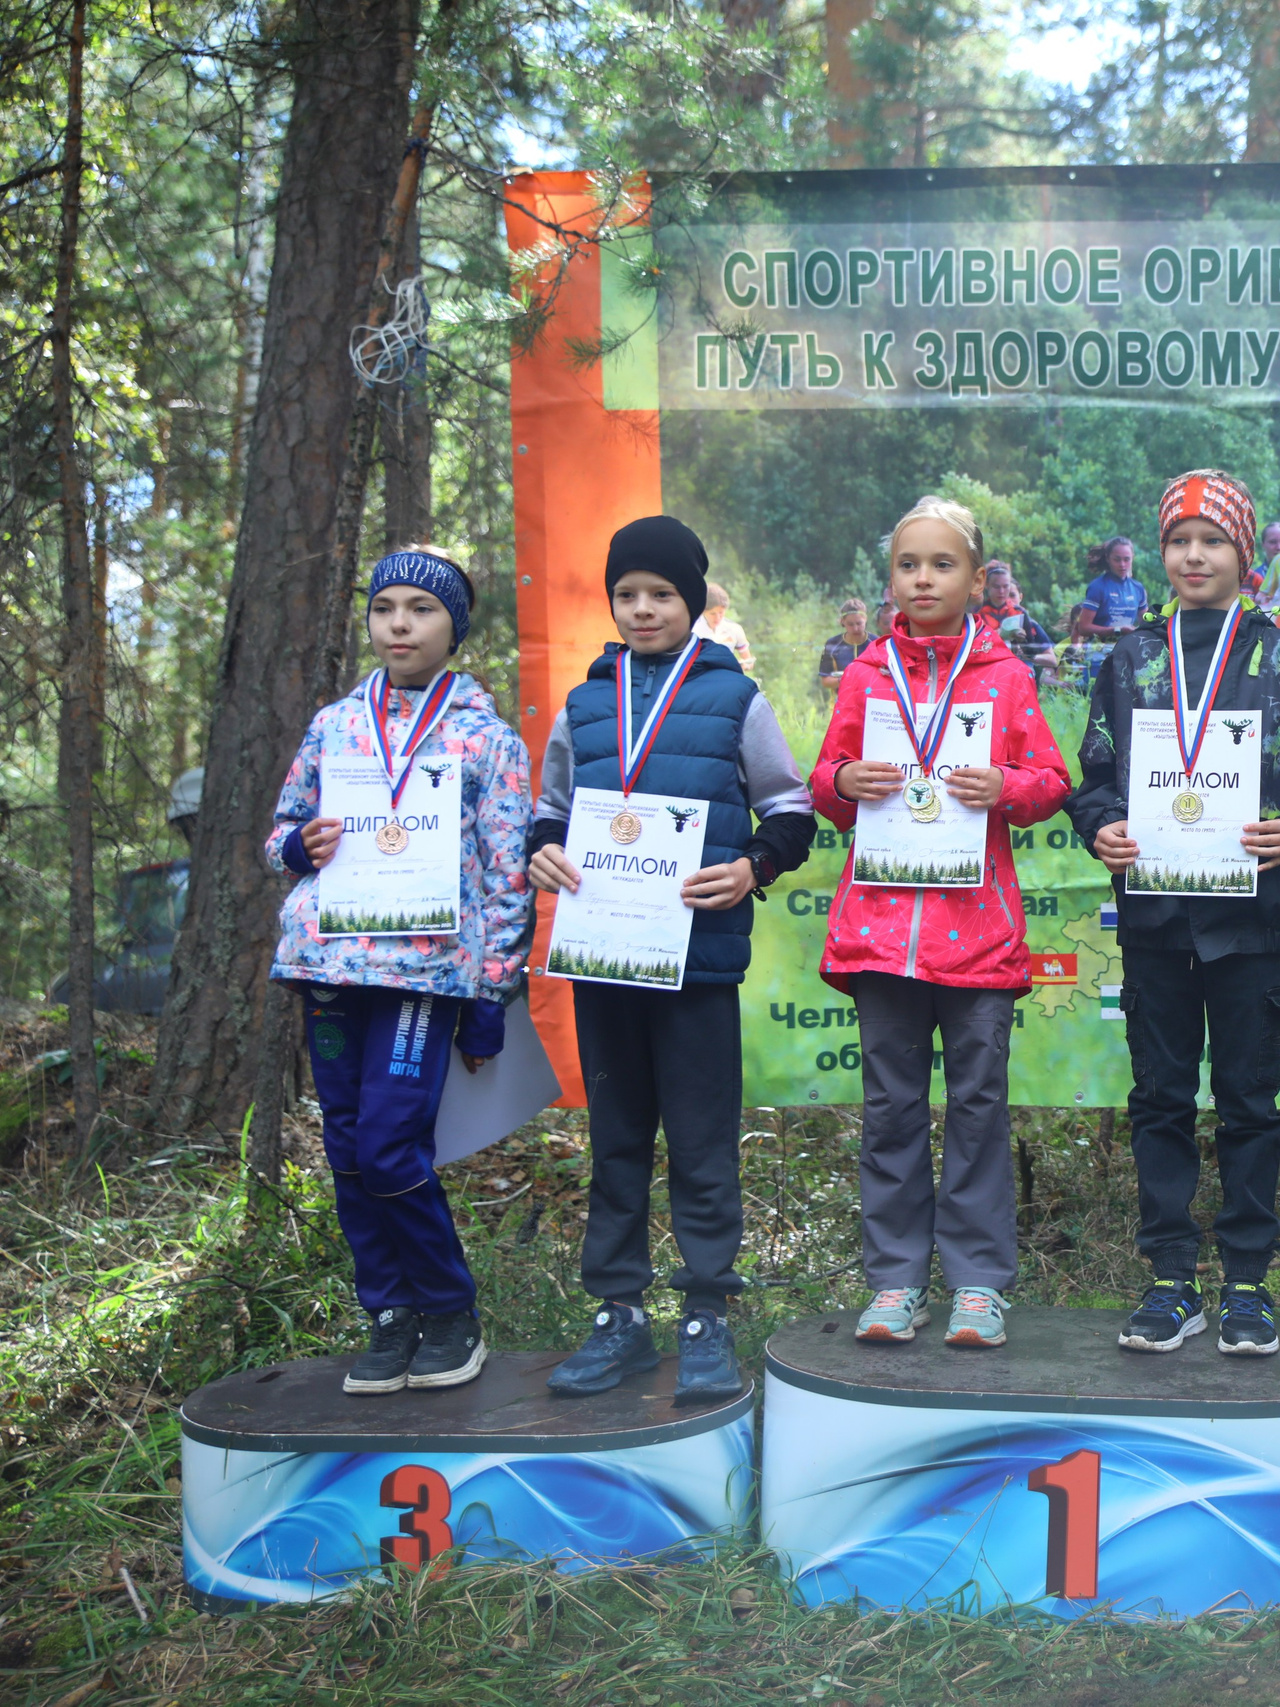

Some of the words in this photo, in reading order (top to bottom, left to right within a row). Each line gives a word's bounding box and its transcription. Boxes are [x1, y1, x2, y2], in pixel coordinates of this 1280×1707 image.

[722, 247, 1121, 308] СПОРТИВНОЕ
[695, 331, 842, 390] ПУТЬ
[863, 331, 897, 389] К
[914, 330, 1279, 397] ЗДОРОВОМУ
[1149, 771, 1239, 788] ДИПЛОМ
[582, 852, 677, 877] ДИПЛОМ
[392, 1000, 415, 1061] СПОРТИВНОЕ
[410, 992, 435, 1063] ОРИЕНТИРОВА
[389, 1061, 420, 1078] ЮГРА
[380, 1465, 453, 1580] 3
[1026, 1449, 1101, 1601] 1
